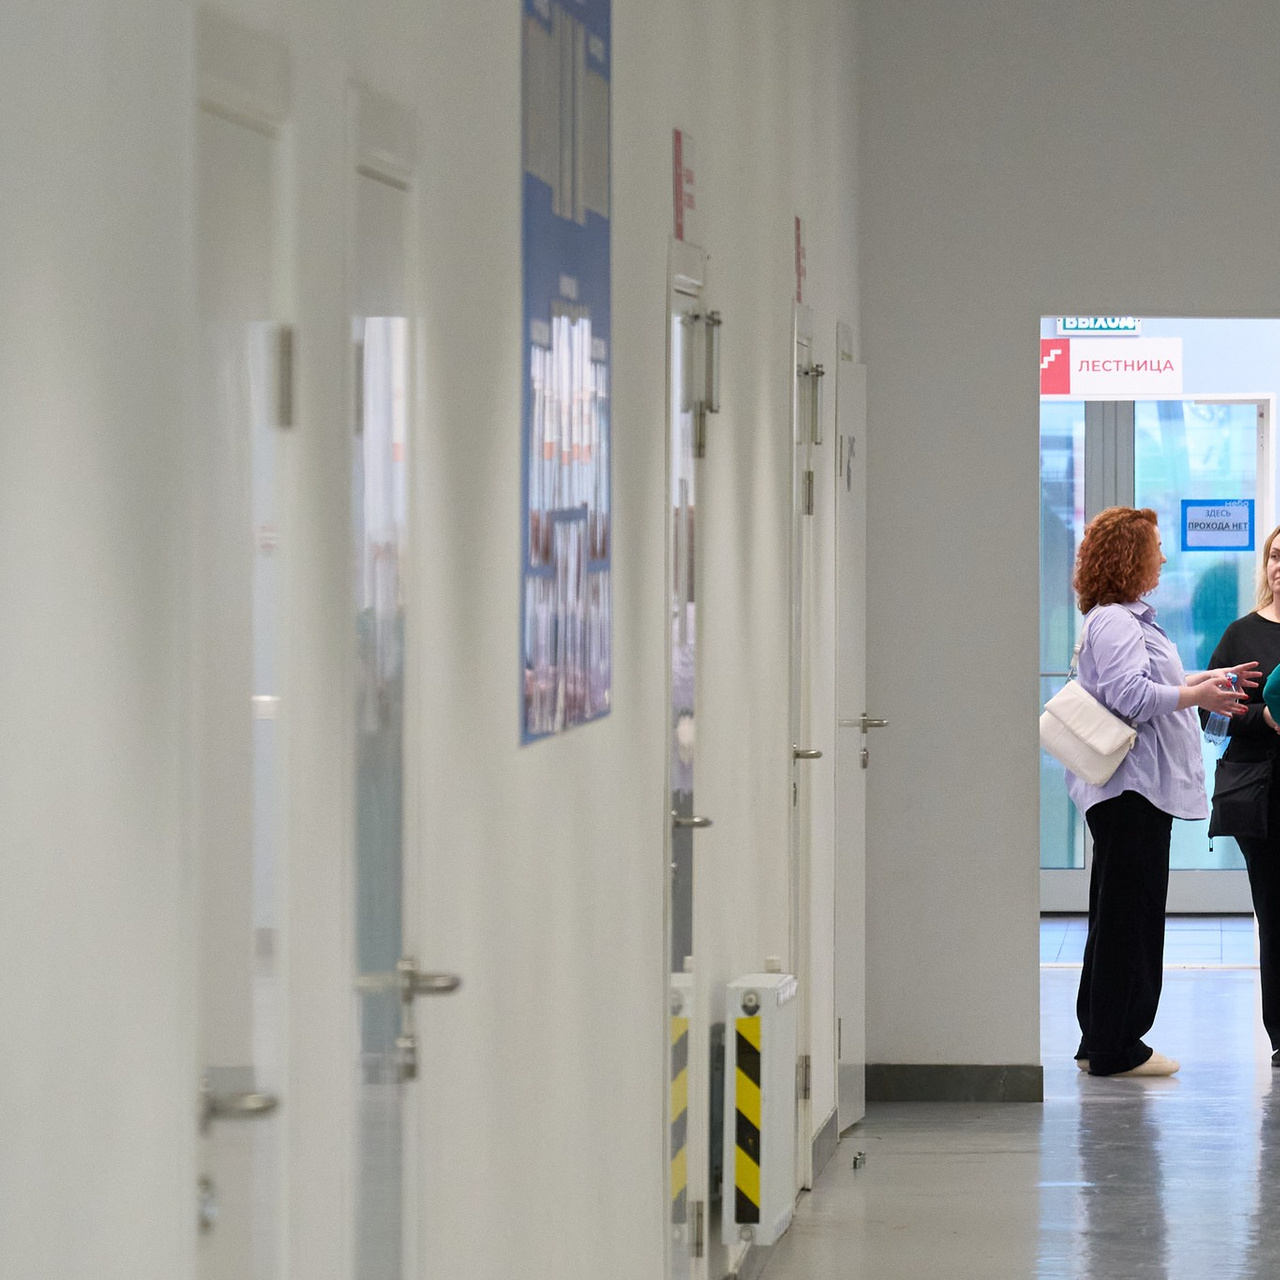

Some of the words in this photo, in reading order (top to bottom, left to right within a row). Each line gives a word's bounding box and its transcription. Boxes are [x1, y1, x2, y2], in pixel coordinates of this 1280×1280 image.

[1078, 360, 1174, 373] ЛЕСТНИЦА
[1204, 509, 1231, 518] ЗДЕСЬ
[1188, 521, 1230, 530] ПРОХОДА
[1232, 521, 1248, 530] НЕТ
